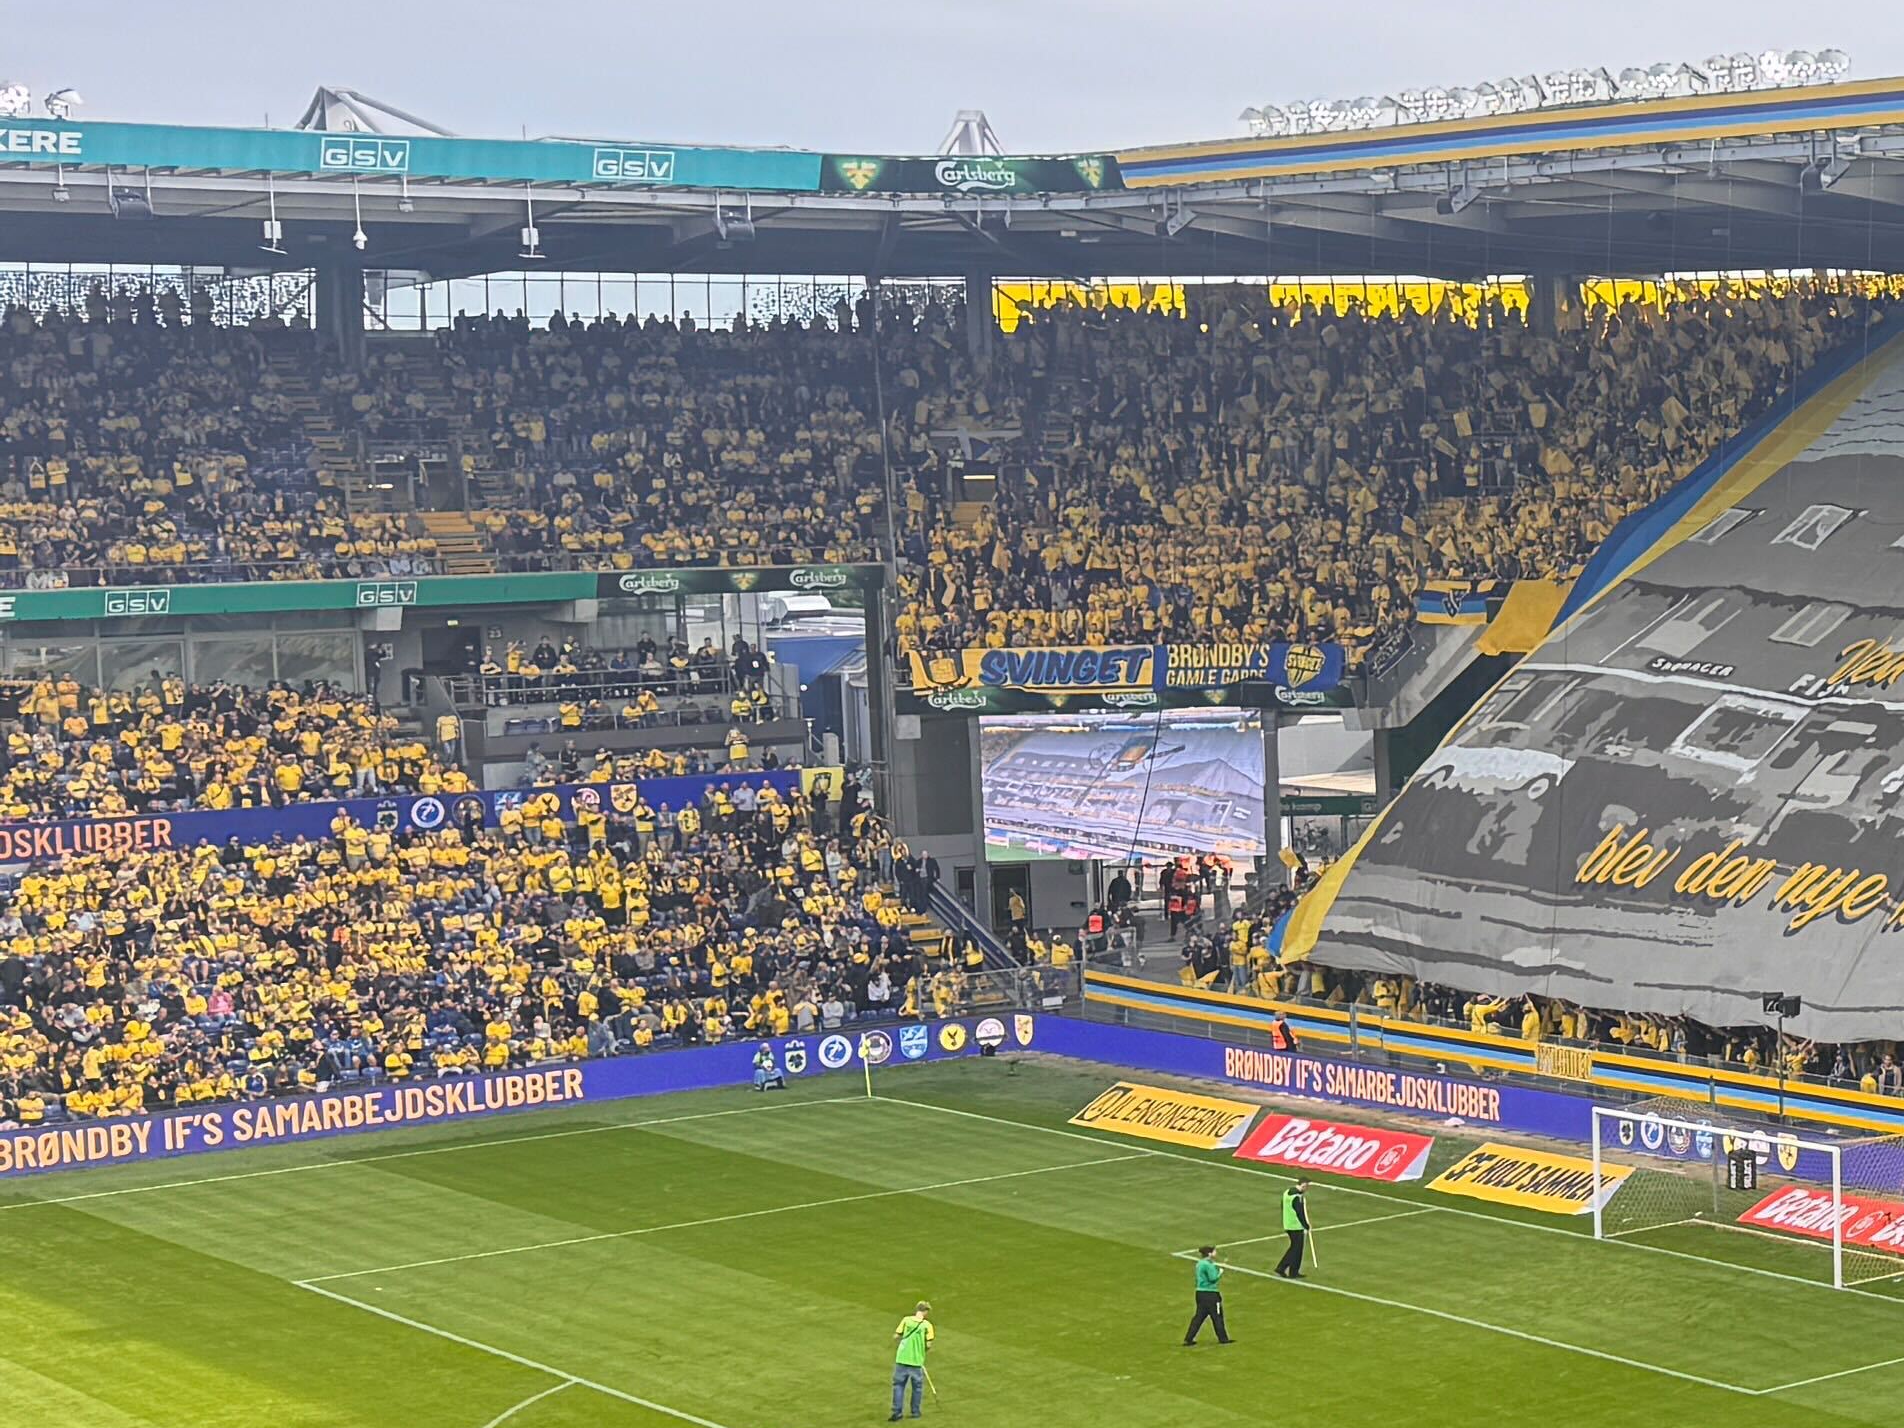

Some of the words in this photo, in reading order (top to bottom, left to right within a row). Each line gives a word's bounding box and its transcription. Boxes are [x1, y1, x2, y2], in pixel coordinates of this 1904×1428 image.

[326, 147, 406, 169] GSV
[597, 156, 672, 177] GSV
[936, 161, 1015, 190] Carlsberg
[360, 585, 416, 604] GSV
[619, 574, 679, 595] Carlsberg
[108, 593, 167, 613] GSV
[978, 648, 1151, 685] SVINGET
[1167, 643, 1270, 668] BRØNDBY'S
[1166, 669, 1217, 687] GAMLE
[1575, 822, 1682, 884] blev
[1674, 839, 1778, 904] den
[1772, 861, 1888, 934] nye
[1225, 1047, 1292, 1087] BRØNDBY
[1296, 1055, 1323, 1088] IF'S
[1325, 1064, 1501, 1122] SAMARBEJDSKLUBBER
[0, 1121, 150, 1170] BRØNDBY
[163, 1113, 224, 1152] IF'S
[233, 1068, 585, 1139] SAMARBEJDSKLUBBER
[1121, 1099, 1246, 1138] ENGINEERING
[1258, 1117, 1380, 1170] Betano
[1445, 1150, 1498, 1182] 3F
[1476, 1158, 1535, 1190] HOLD
[1517, 1164, 1617, 1202] SAMMEN
[1754, 1188, 1859, 1232] Betano
